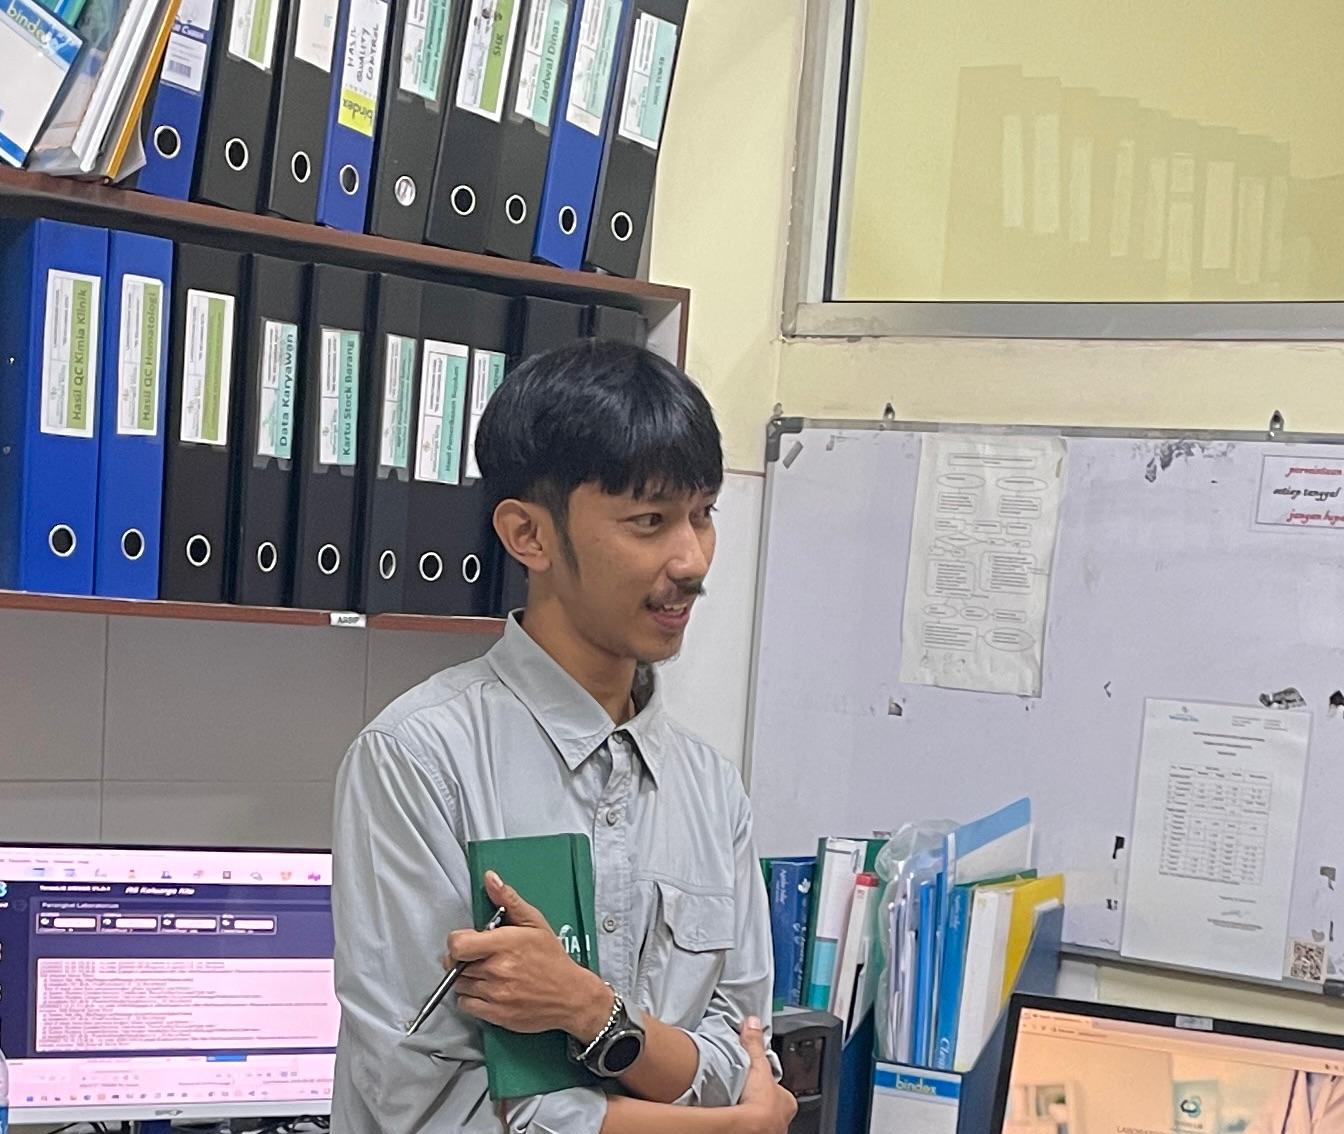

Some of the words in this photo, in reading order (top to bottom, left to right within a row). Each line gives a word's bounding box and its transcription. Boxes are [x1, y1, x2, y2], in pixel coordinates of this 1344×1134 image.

[546, 19, 560, 55] Dinas
[540, 58, 554, 103] Jadwal
[343, 98, 374, 126] bindex
[76, 288, 87, 325] Klinik
[74, 327, 86, 363] Kimia
[145, 292, 157, 365] Hematologi
[74, 366, 84, 386] QC
[144, 368, 153, 387] QC
[280, 333, 294, 408] Karyawan
[344, 340, 355, 384] Barang
[72, 388, 82, 421] Hasil
[142, 389, 152, 421] Hasil
[343, 387, 353, 419] Stock
[279, 411, 290, 447] Data
[342, 422, 352, 456] Kartu
[896, 1073, 937, 1095] bindex
